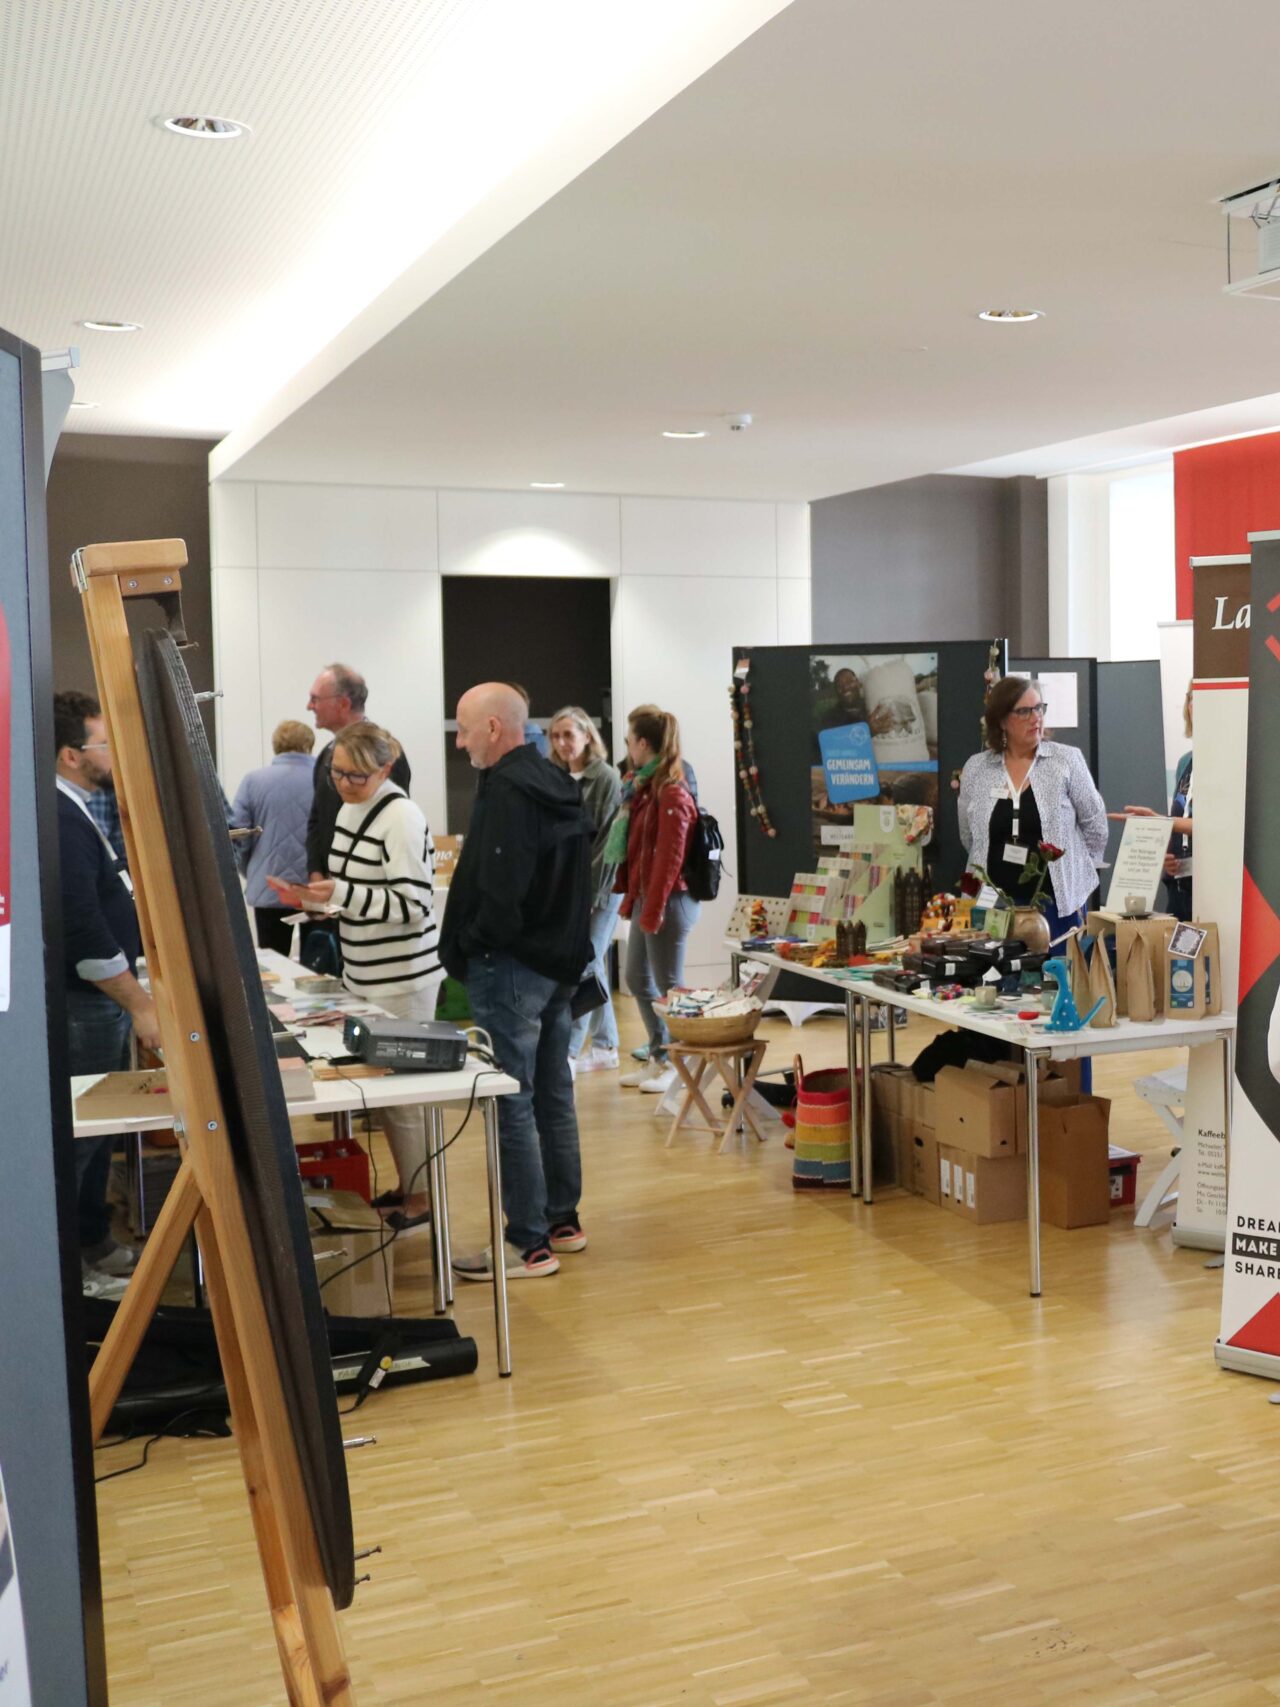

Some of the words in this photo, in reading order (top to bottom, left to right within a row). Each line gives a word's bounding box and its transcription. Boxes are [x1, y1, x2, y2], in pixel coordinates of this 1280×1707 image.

[826, 759, 871, 771] GEMEINSAM
[831, 772, 874, 785] VERÄNDERN
[1235, 1238, 1277, 1256] MAKE
